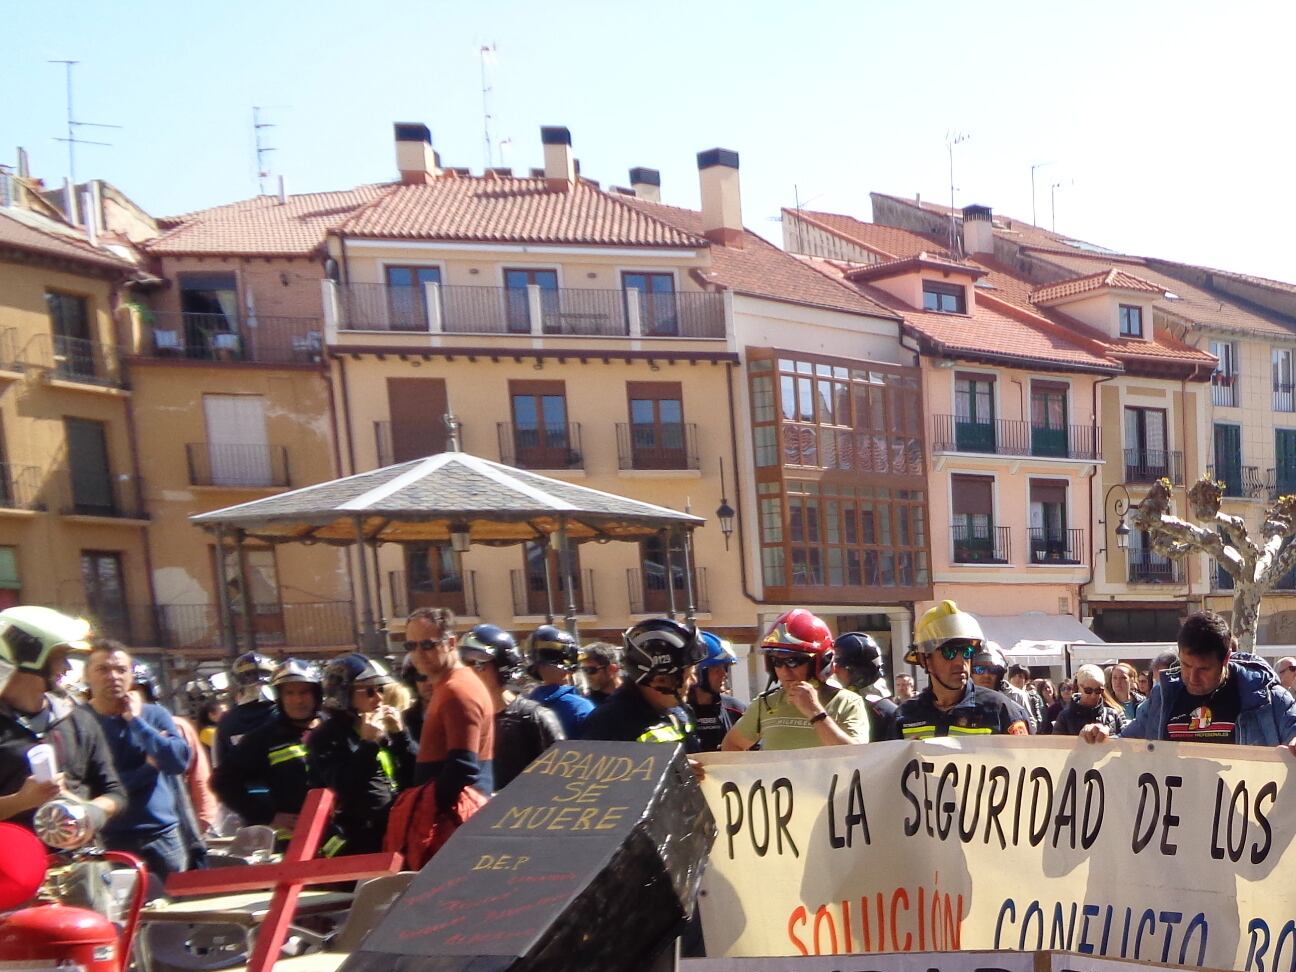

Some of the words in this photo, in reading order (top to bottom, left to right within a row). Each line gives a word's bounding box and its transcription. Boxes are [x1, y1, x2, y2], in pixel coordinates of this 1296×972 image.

[523, 749, 656, 782] ARANDA
[551, 781, 609, 803] SE
[492, 806, 629, 832] MUERE
[722, 776, 799, 860] POR
[828, 769, 871, 850] LA
[900, 758, 1105, 851] SEGURIDAD
[1131, 772, 1183, 856] DE
[1210, 777, 1278, 866] LOS
